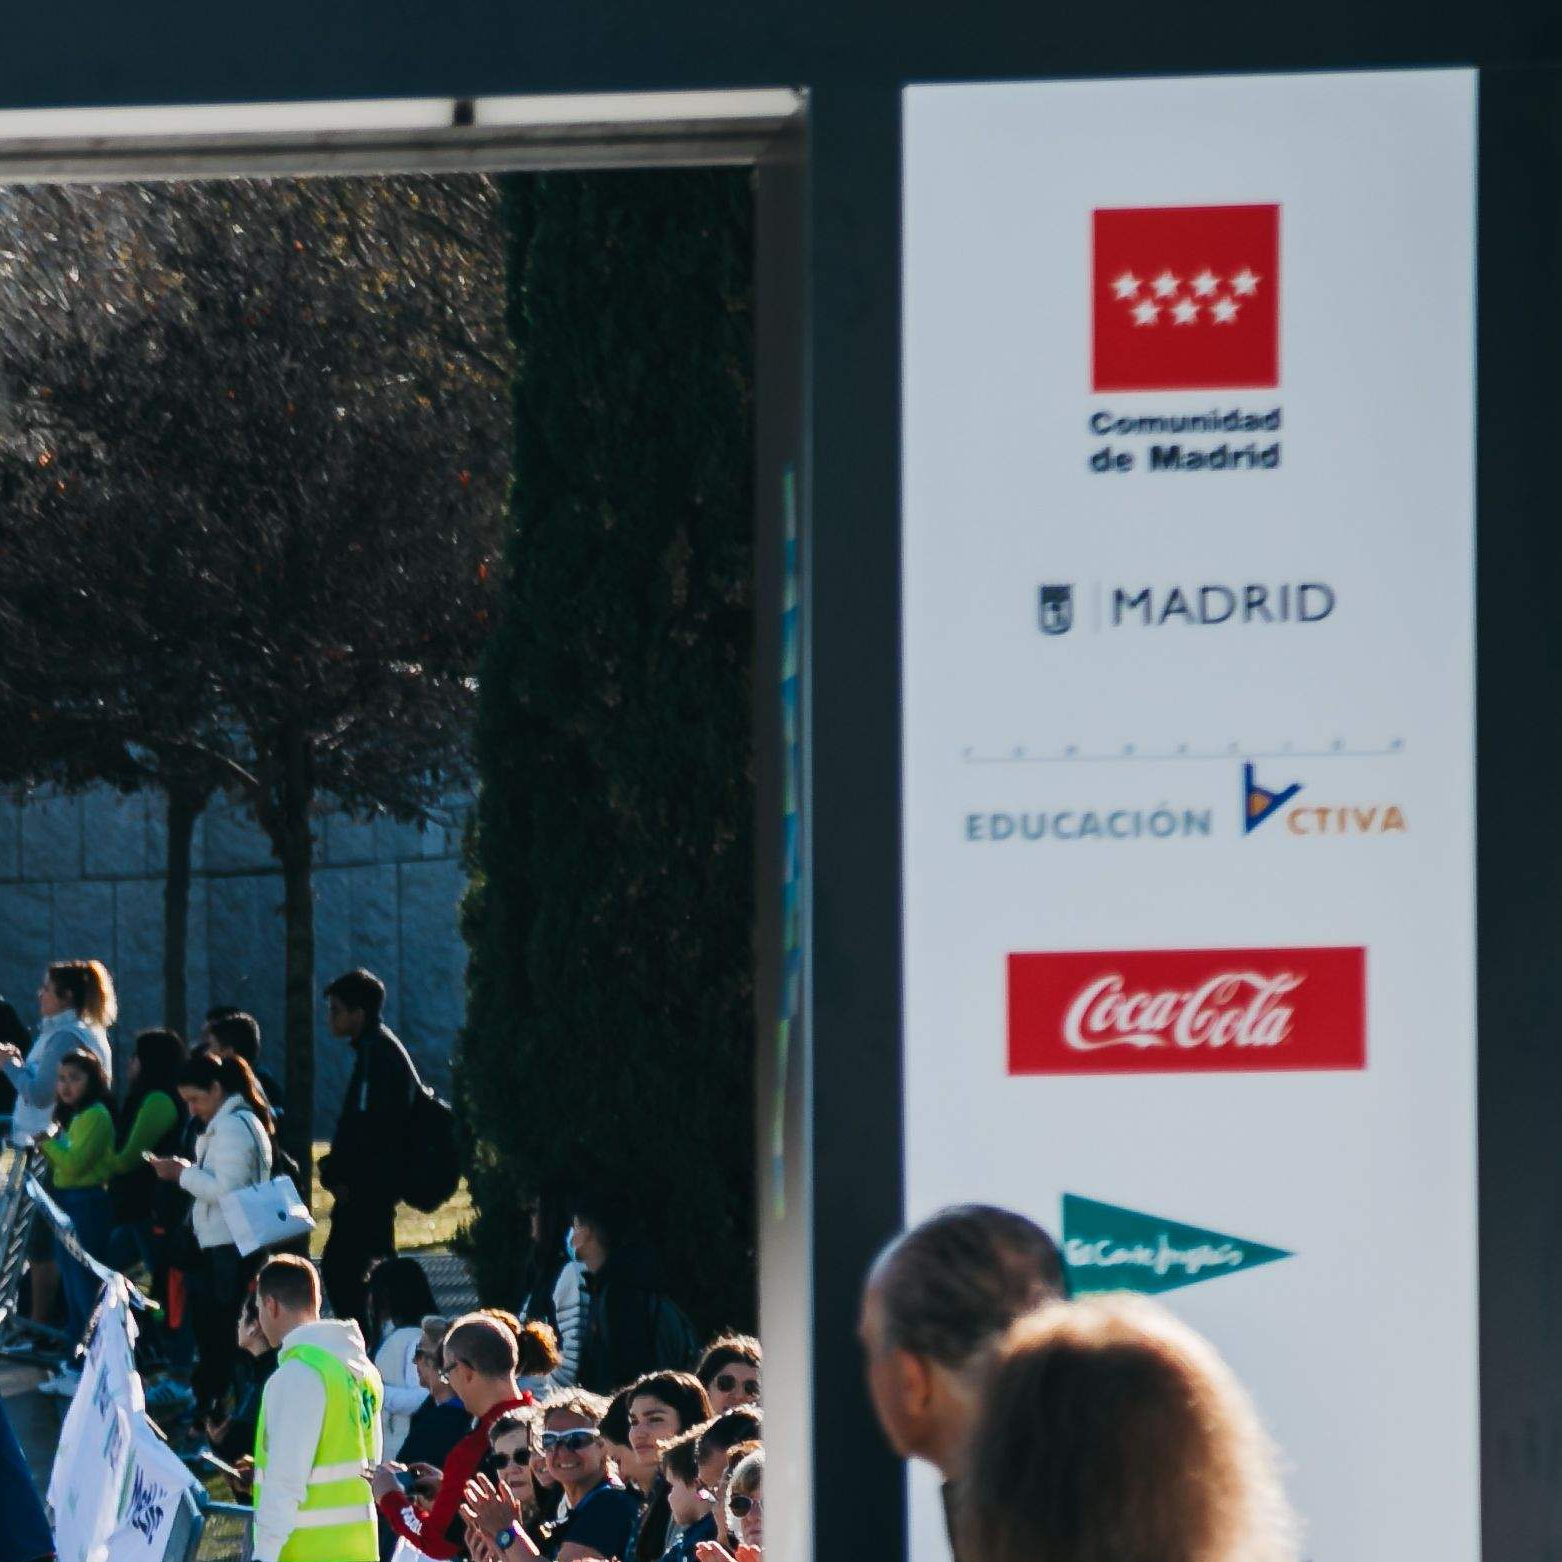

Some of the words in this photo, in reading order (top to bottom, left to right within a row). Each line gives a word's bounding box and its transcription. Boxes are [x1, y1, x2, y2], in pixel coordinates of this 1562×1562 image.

[1090, 408, 1282, 435] Comunidad
[1090, 446, 1133, 472] de
[1150, 442, 1282, 471] Madrid
[1113, 583, 1337, 627] MADRID
[965, 801, 1213, 841] EDUCACIÓN
